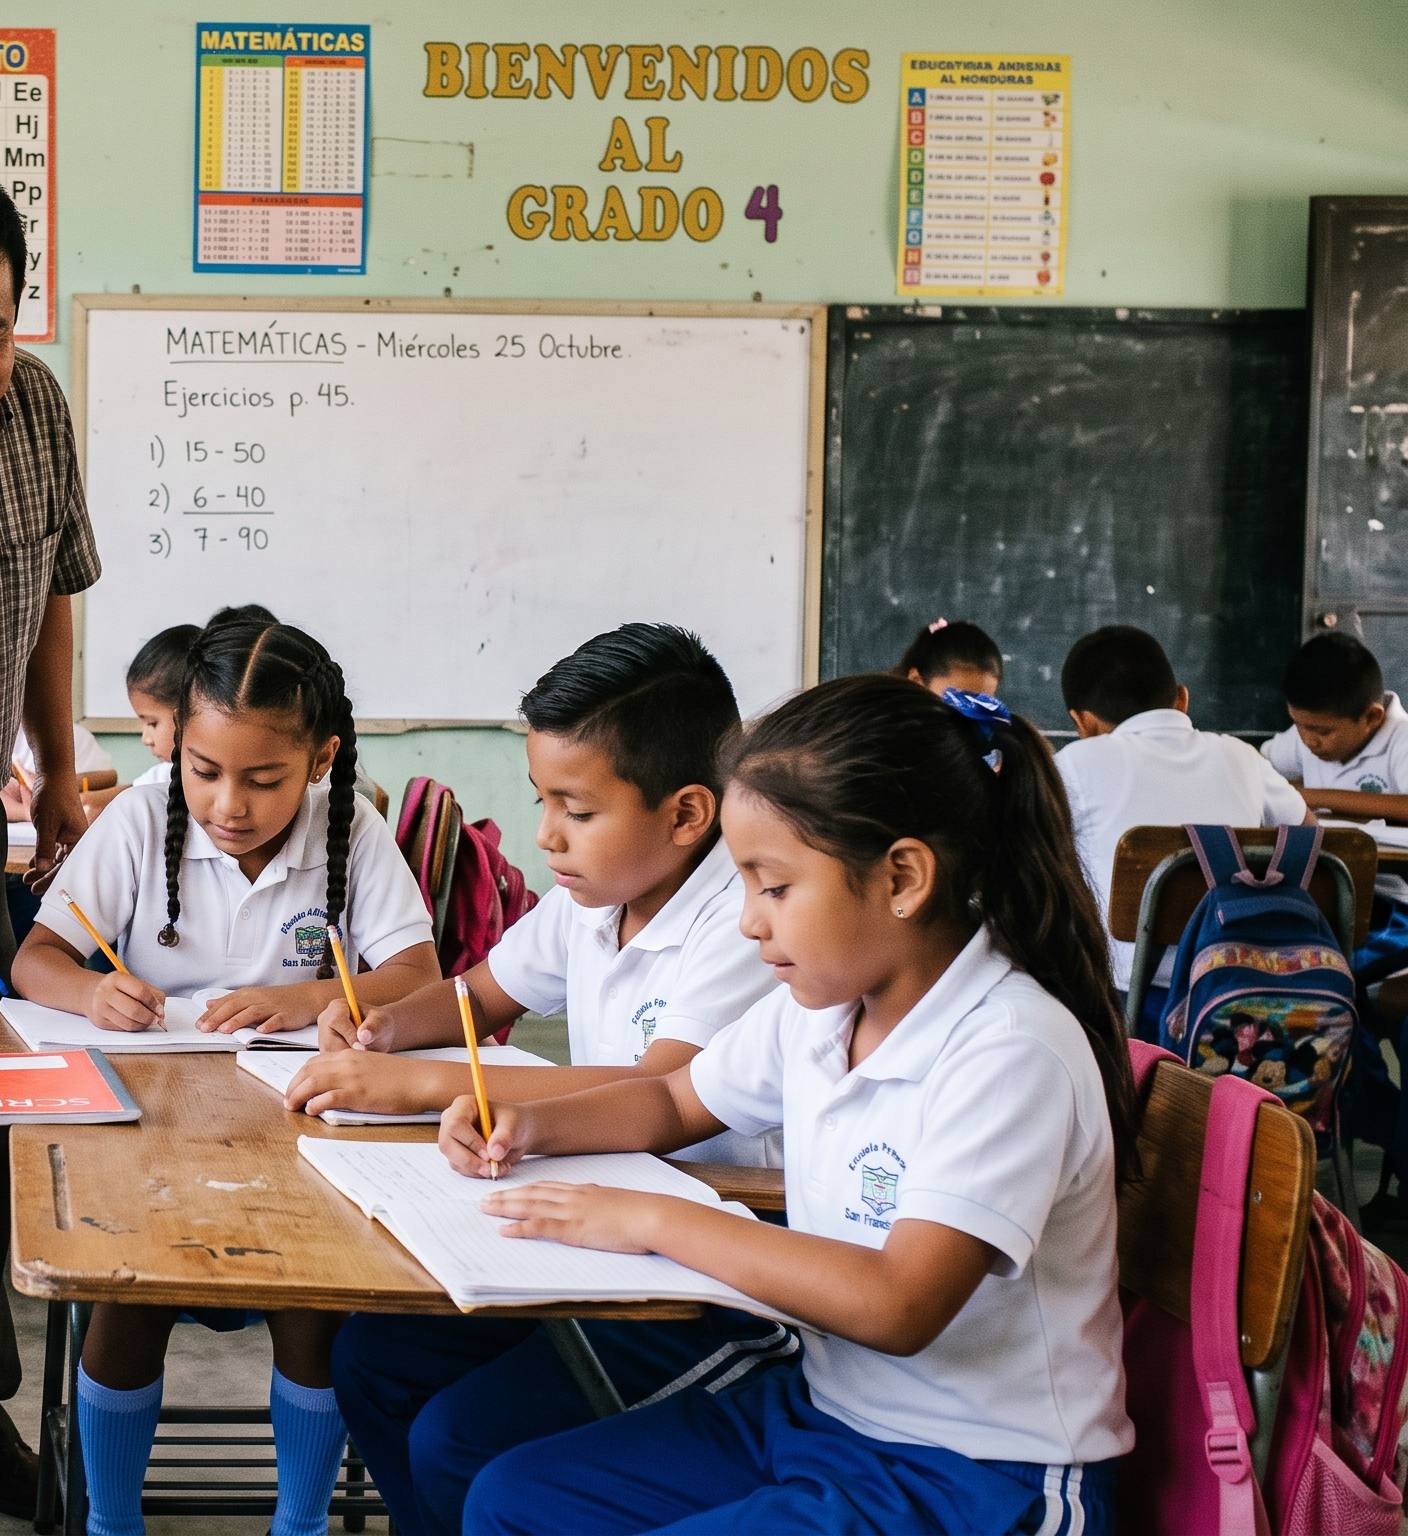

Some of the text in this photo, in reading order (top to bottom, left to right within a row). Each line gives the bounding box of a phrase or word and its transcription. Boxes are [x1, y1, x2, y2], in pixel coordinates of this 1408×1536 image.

[200, 27, 366, 52] MATEMÁTICAS
[422, 41, 871, 103] BIENVENIDOS
[960, 74, 1035, 85] HONDURAS
[14, 82, 43, 103] Ee
[16, 114, 40, 140] Hj
[5, 148, 46, 168] Mm
[598, 115, 683, 173] AL
[12, 181, 43, 205] Pp
[505, 183, 784, 243] GRADO 4
[166, 321, 348, 359] MATEMÁTICAS
[376, 331, 481, 361] Miércoles
[494, 333, 527, 358] 25
[163, 380, 356, 419] Ejercicios p. 45.
[149, 435, 166, 469] 1)
[149, 482, 171, 515] 2)
[149, 531, 172, 559] 3)
[238, 527, 269, 551] 90
